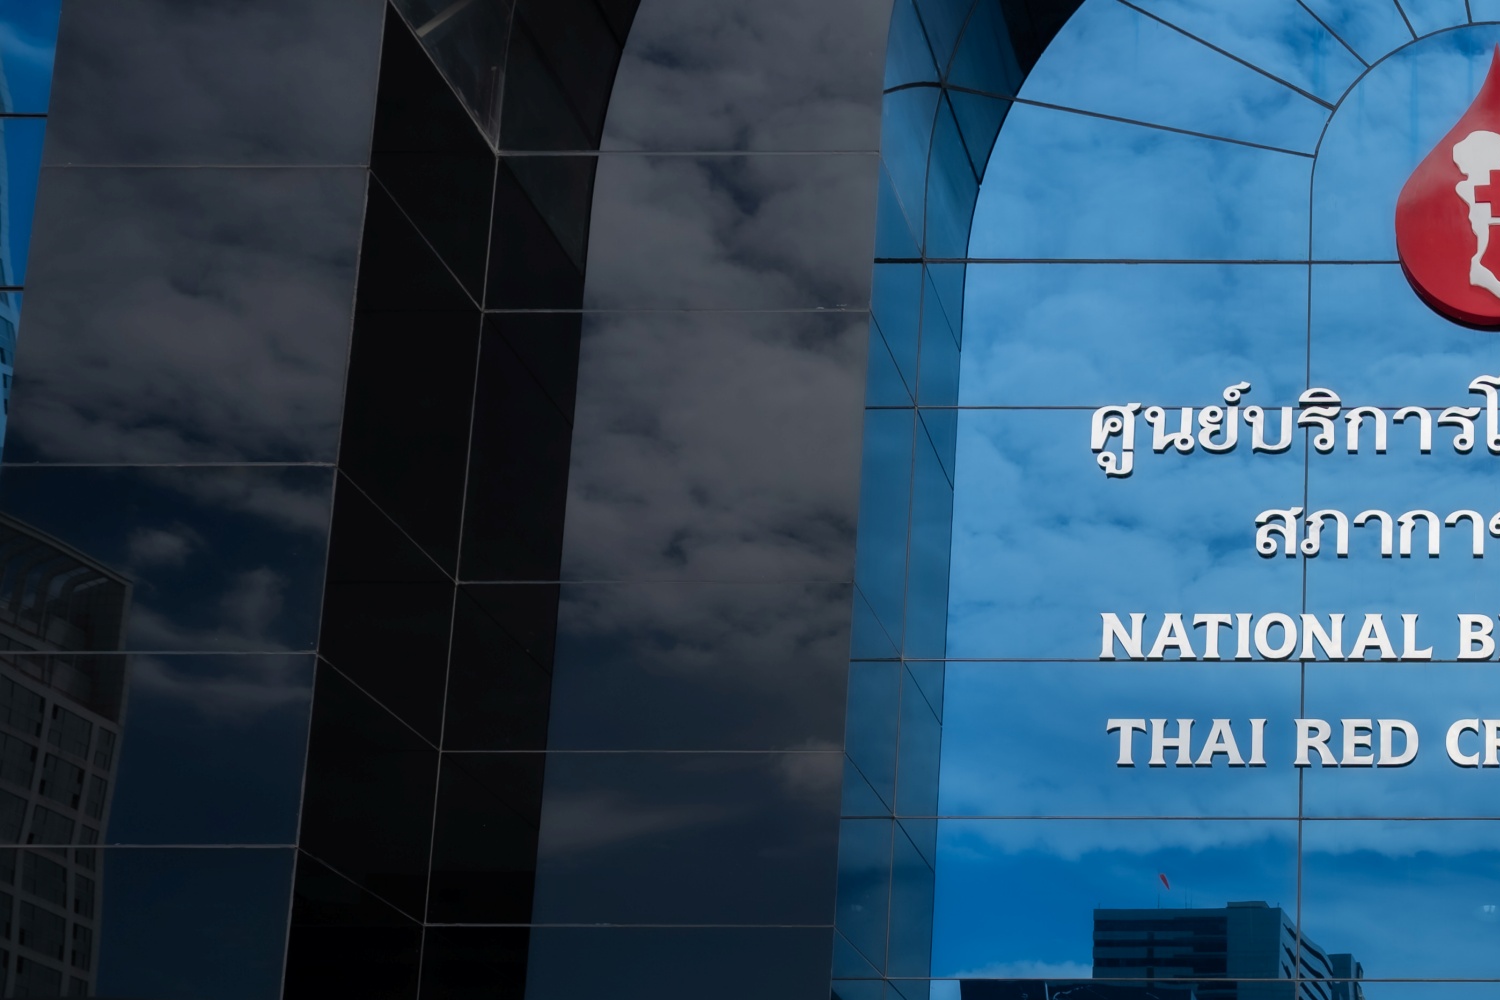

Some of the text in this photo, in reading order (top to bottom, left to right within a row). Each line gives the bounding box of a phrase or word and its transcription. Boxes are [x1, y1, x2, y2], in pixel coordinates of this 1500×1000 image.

[1098, 612, 1434, 661] NATIONAL
[1106, 717, 1267, 767] THAI
[1294, 718, 1420, 767] RED
